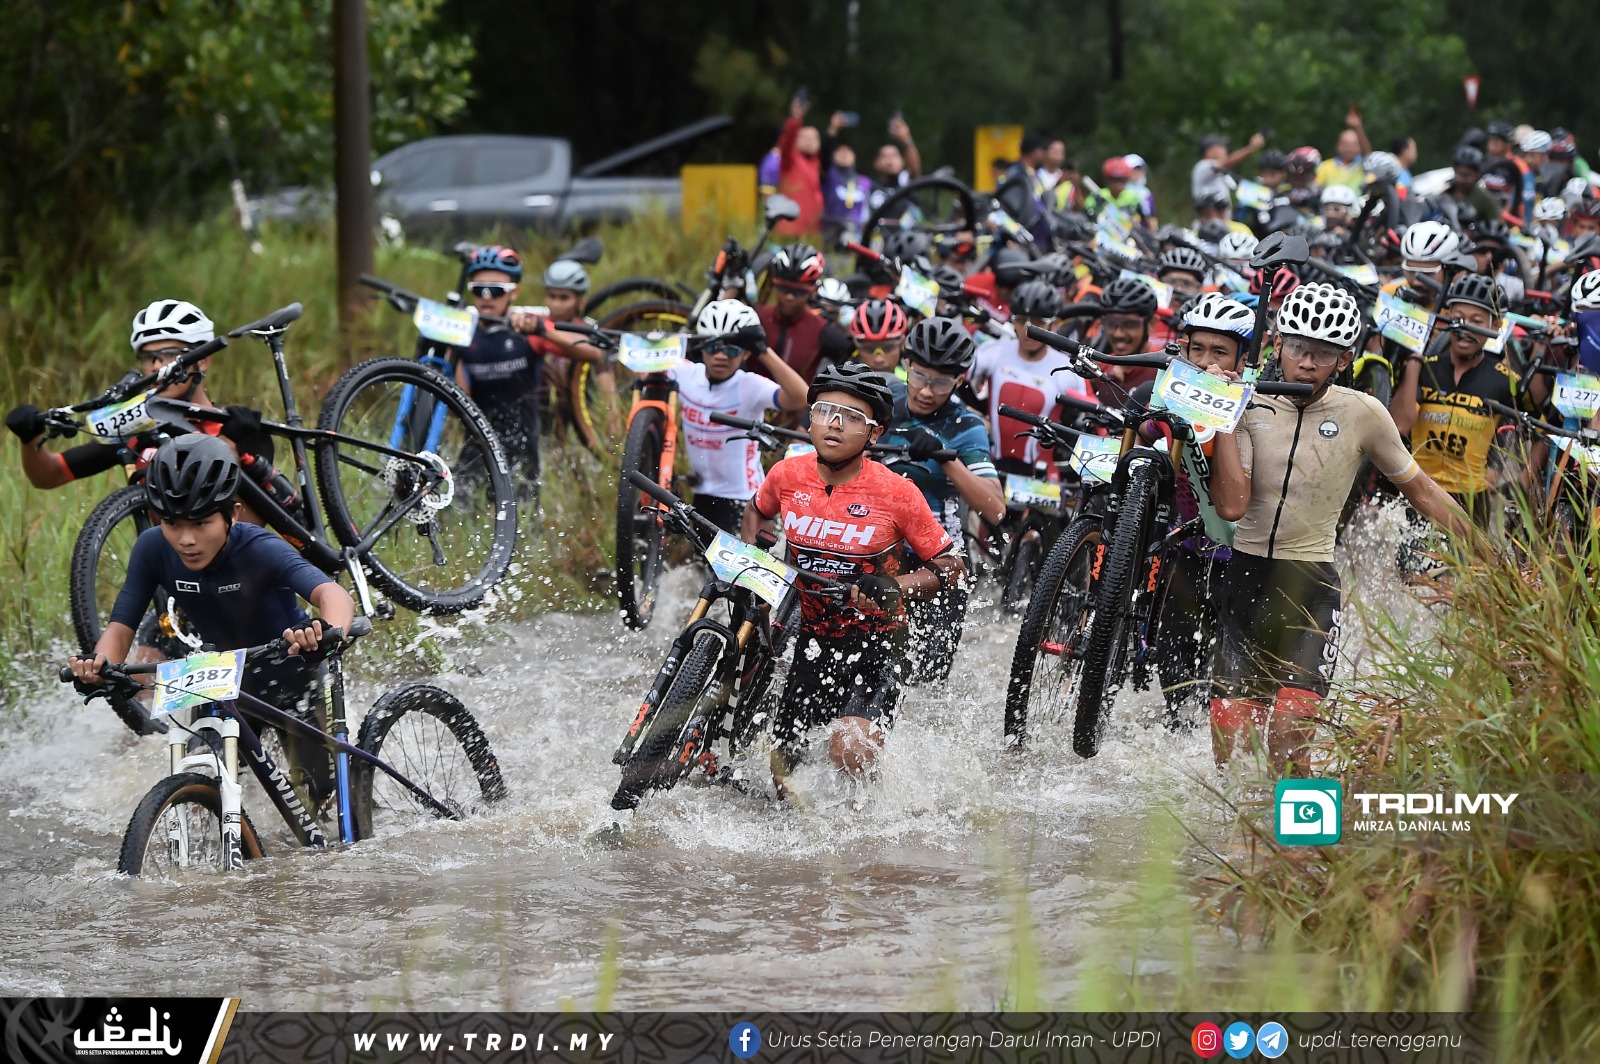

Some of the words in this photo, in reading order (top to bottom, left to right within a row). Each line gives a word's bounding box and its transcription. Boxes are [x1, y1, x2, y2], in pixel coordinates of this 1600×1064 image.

[1381, 308, 1390, 319] A
[1395, 314, 1423, 335] 2315
[1170, 380, 1186, 395] C
[1189, 389, 1236, 413] 2362
[1575, 389, 1600, 402] 277
[95, 422, 109, 437] B
[1080, 450, 1094, 462] D
[794, 535, 825, 547] CYCLING
[827, 542, 854, 551] GROUP
[718, 549, 734, 562] C
[812, 557, 857, 570] PRO
[218, 582, 242, 594] PRO
[165, 679, 179, 695] C
[185, 668, 233, 688] 2387
